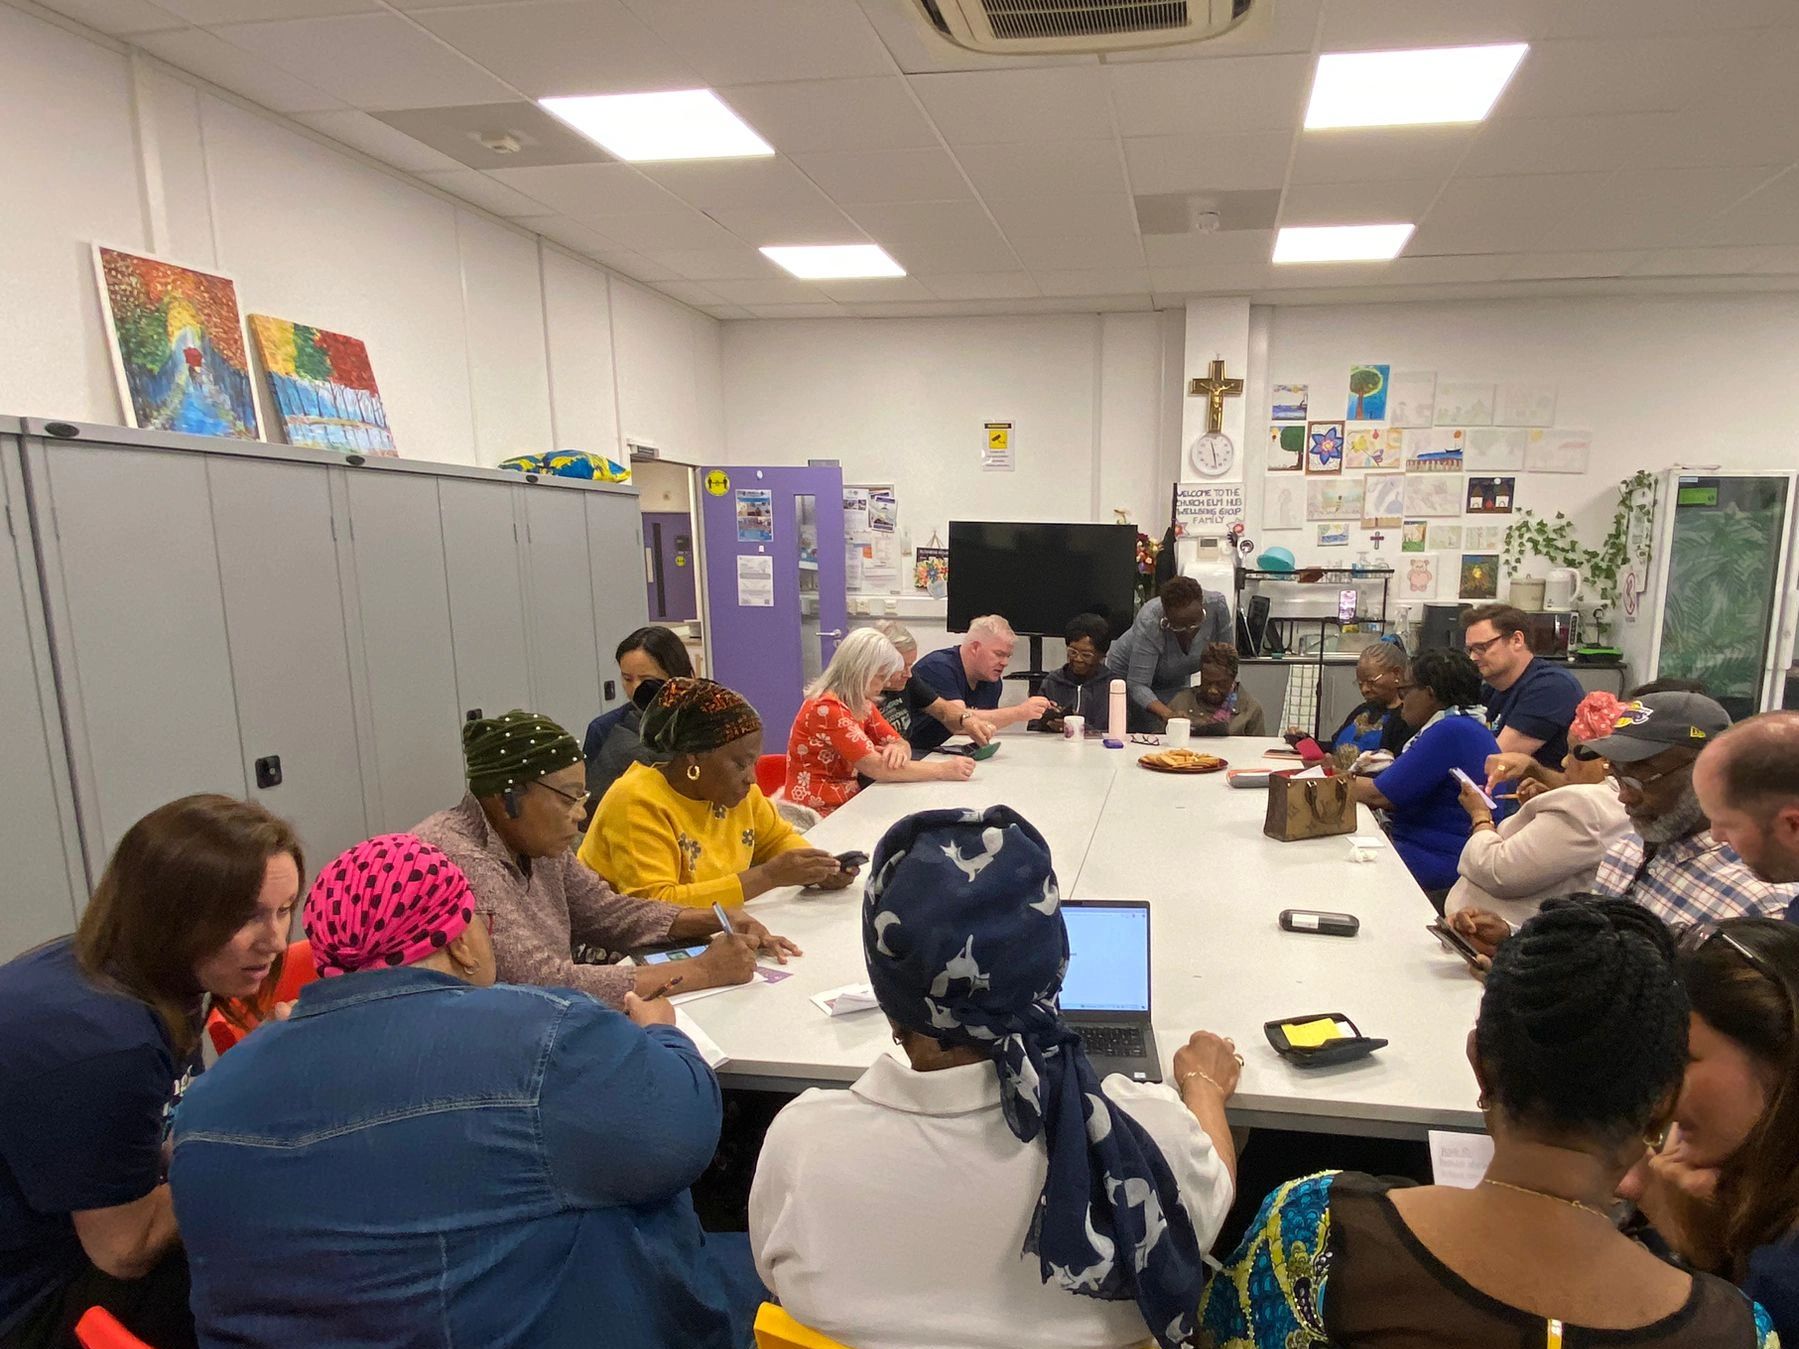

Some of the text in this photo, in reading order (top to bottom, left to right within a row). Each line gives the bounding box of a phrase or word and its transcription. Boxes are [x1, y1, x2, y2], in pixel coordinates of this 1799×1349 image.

[1214, 489, 1224, 497] TO
[1225, 488, 1240, 497] THE
[1206, 499, 1223, 507] ELM
[1226, 498, 1243, 506] HUB
[1193, 516, 1225, 524] FAMILY
